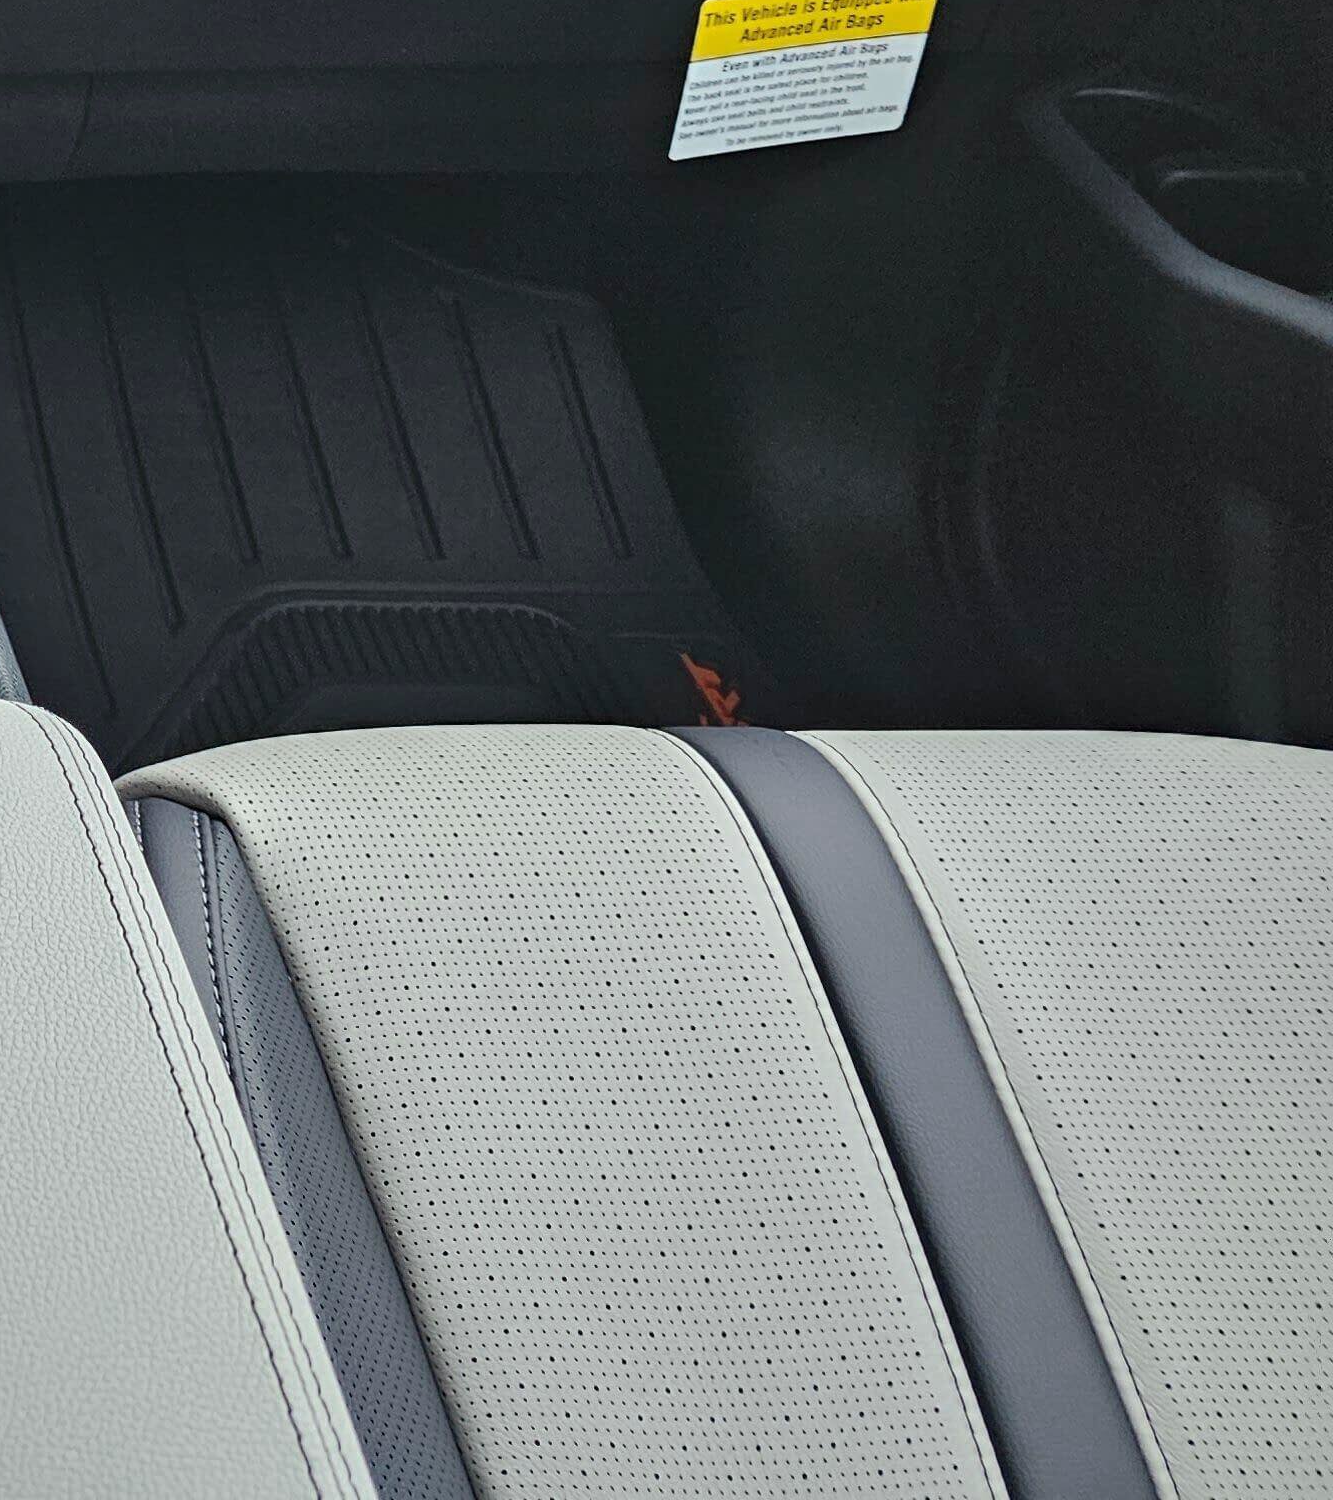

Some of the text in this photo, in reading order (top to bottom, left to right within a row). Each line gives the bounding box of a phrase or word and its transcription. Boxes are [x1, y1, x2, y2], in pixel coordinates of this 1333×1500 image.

[704, 11, 737, 28] This
[742, 1, 797, 22] Vehicle
[739, 12, 885, 43] Advanced Air Bags
